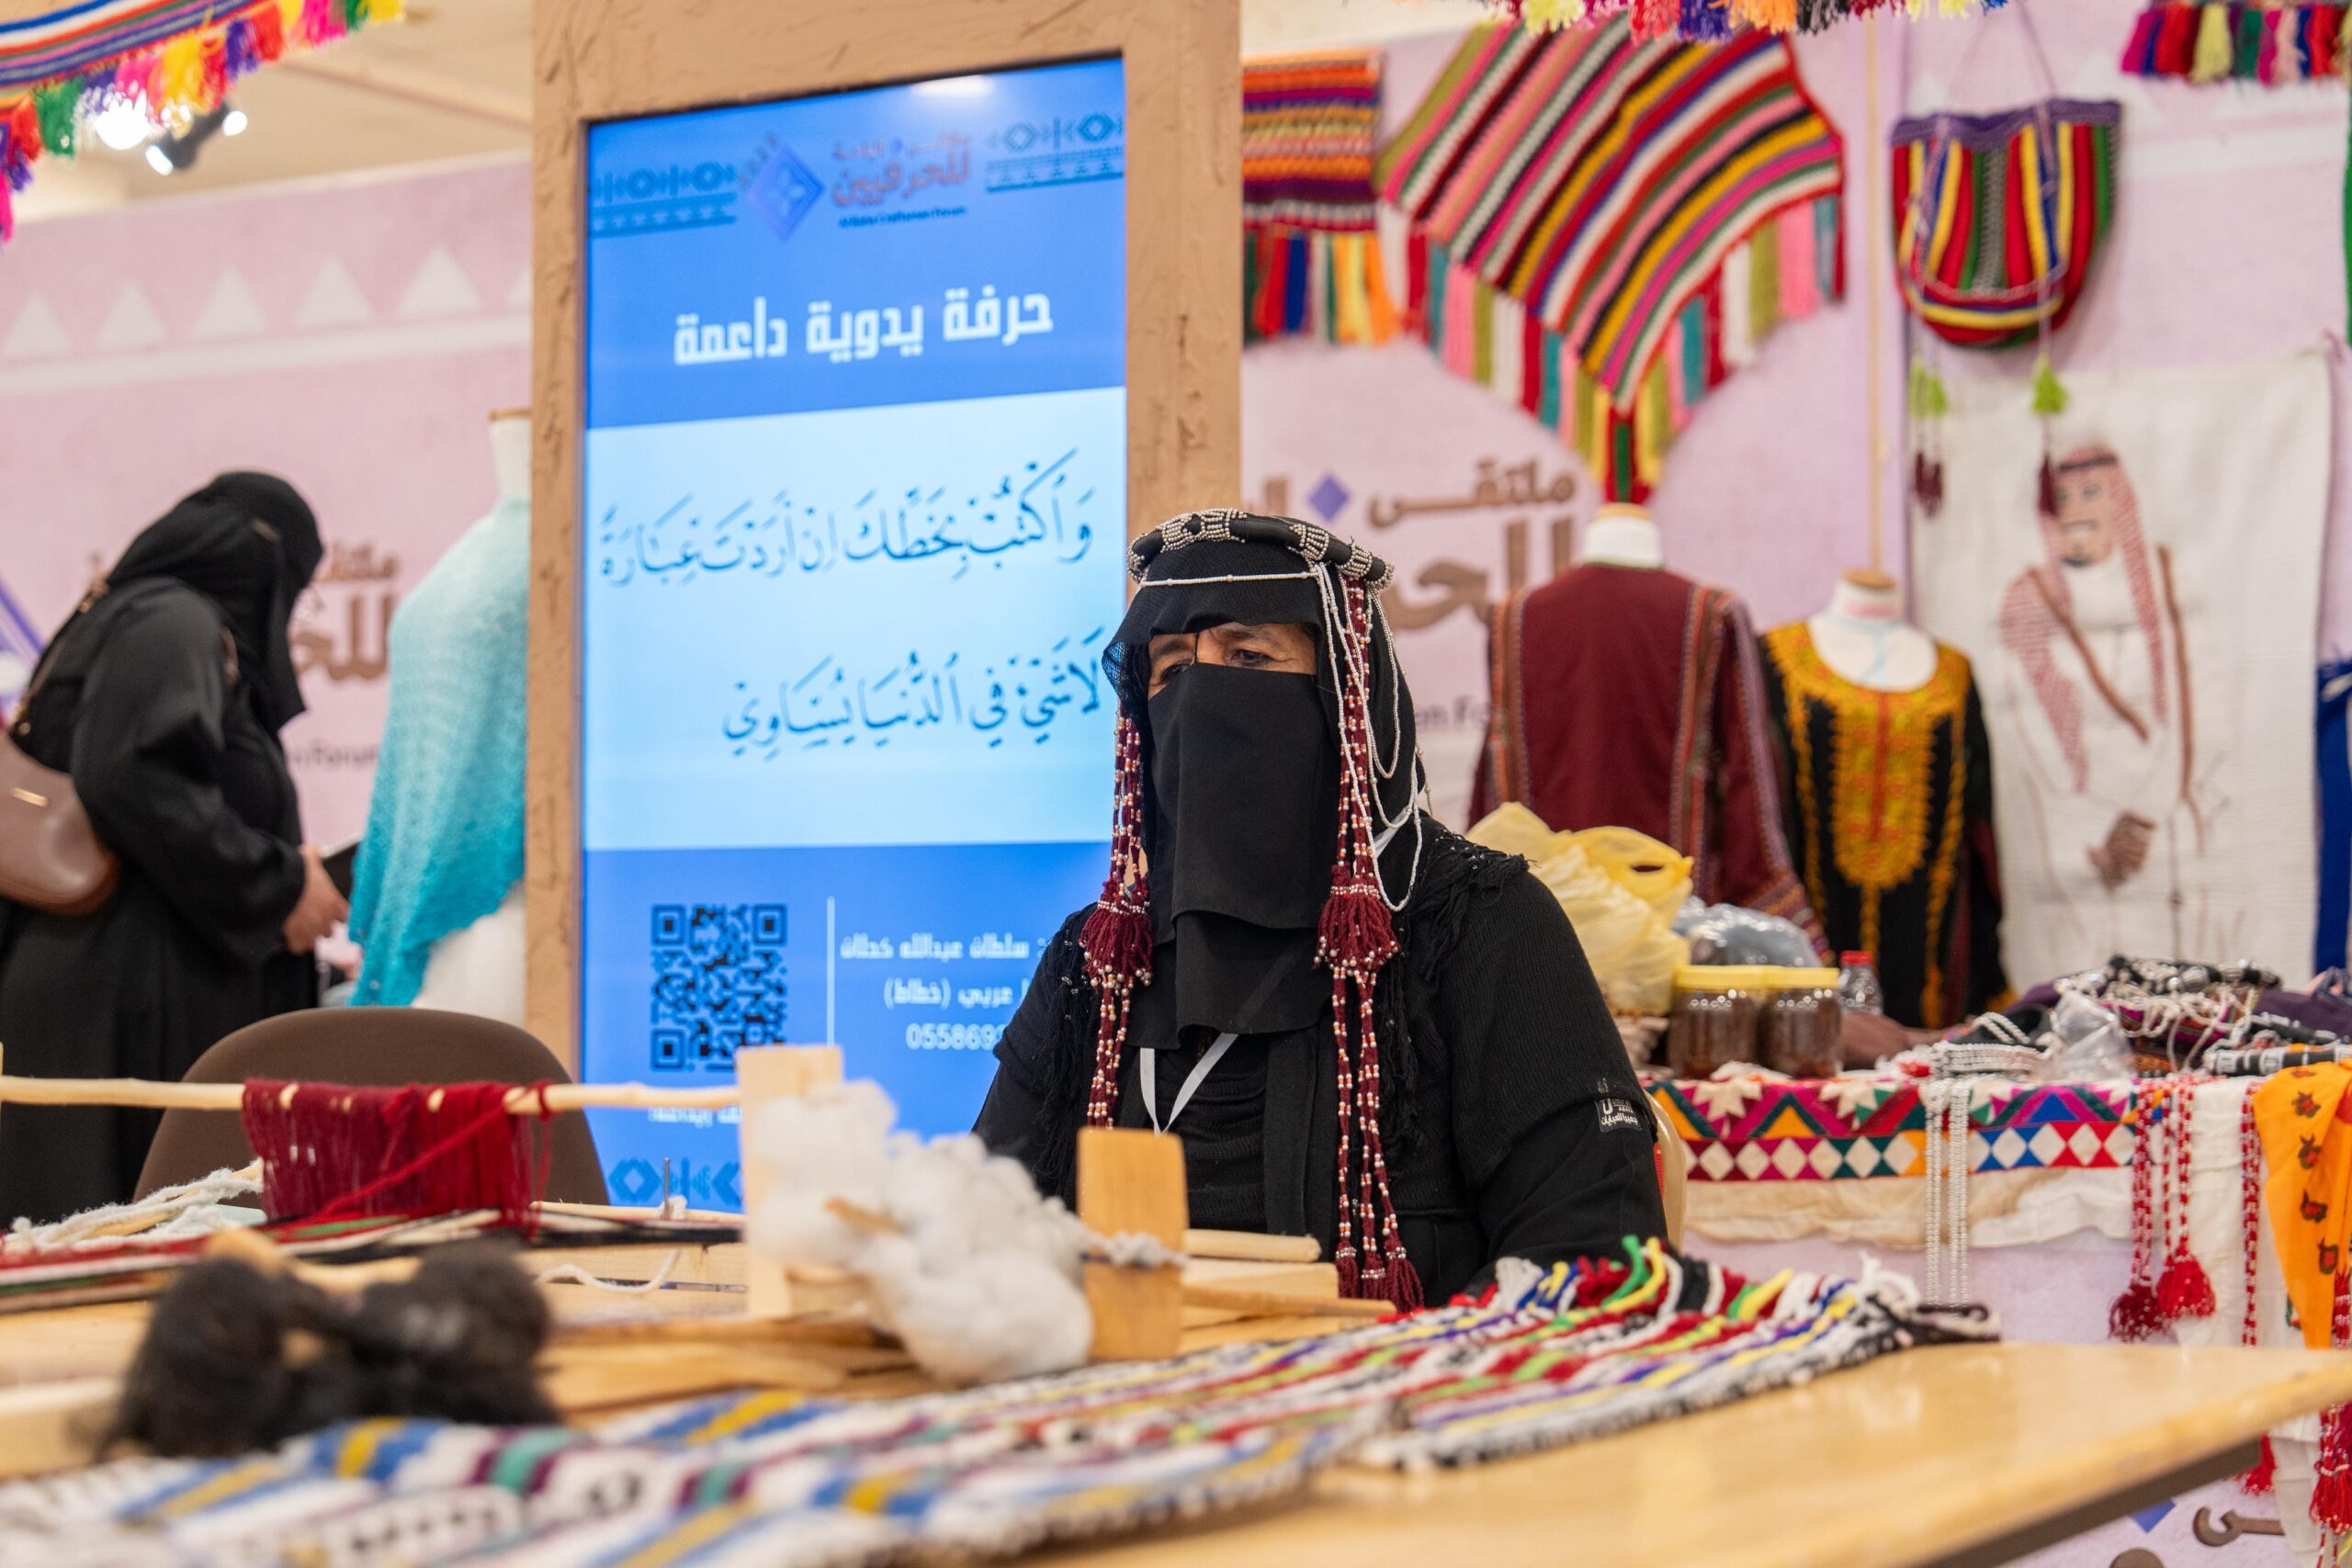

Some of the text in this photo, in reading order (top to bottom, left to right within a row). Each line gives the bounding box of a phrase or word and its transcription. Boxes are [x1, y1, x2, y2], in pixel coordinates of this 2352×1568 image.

[674, 285, 1053, 366] حرفة يدوية داعمة
[1368, 457, 1577, 528] ملتقى
[969, 931, 1030, 960] سلطان
[957, 985, 1013, 1010] عربي
